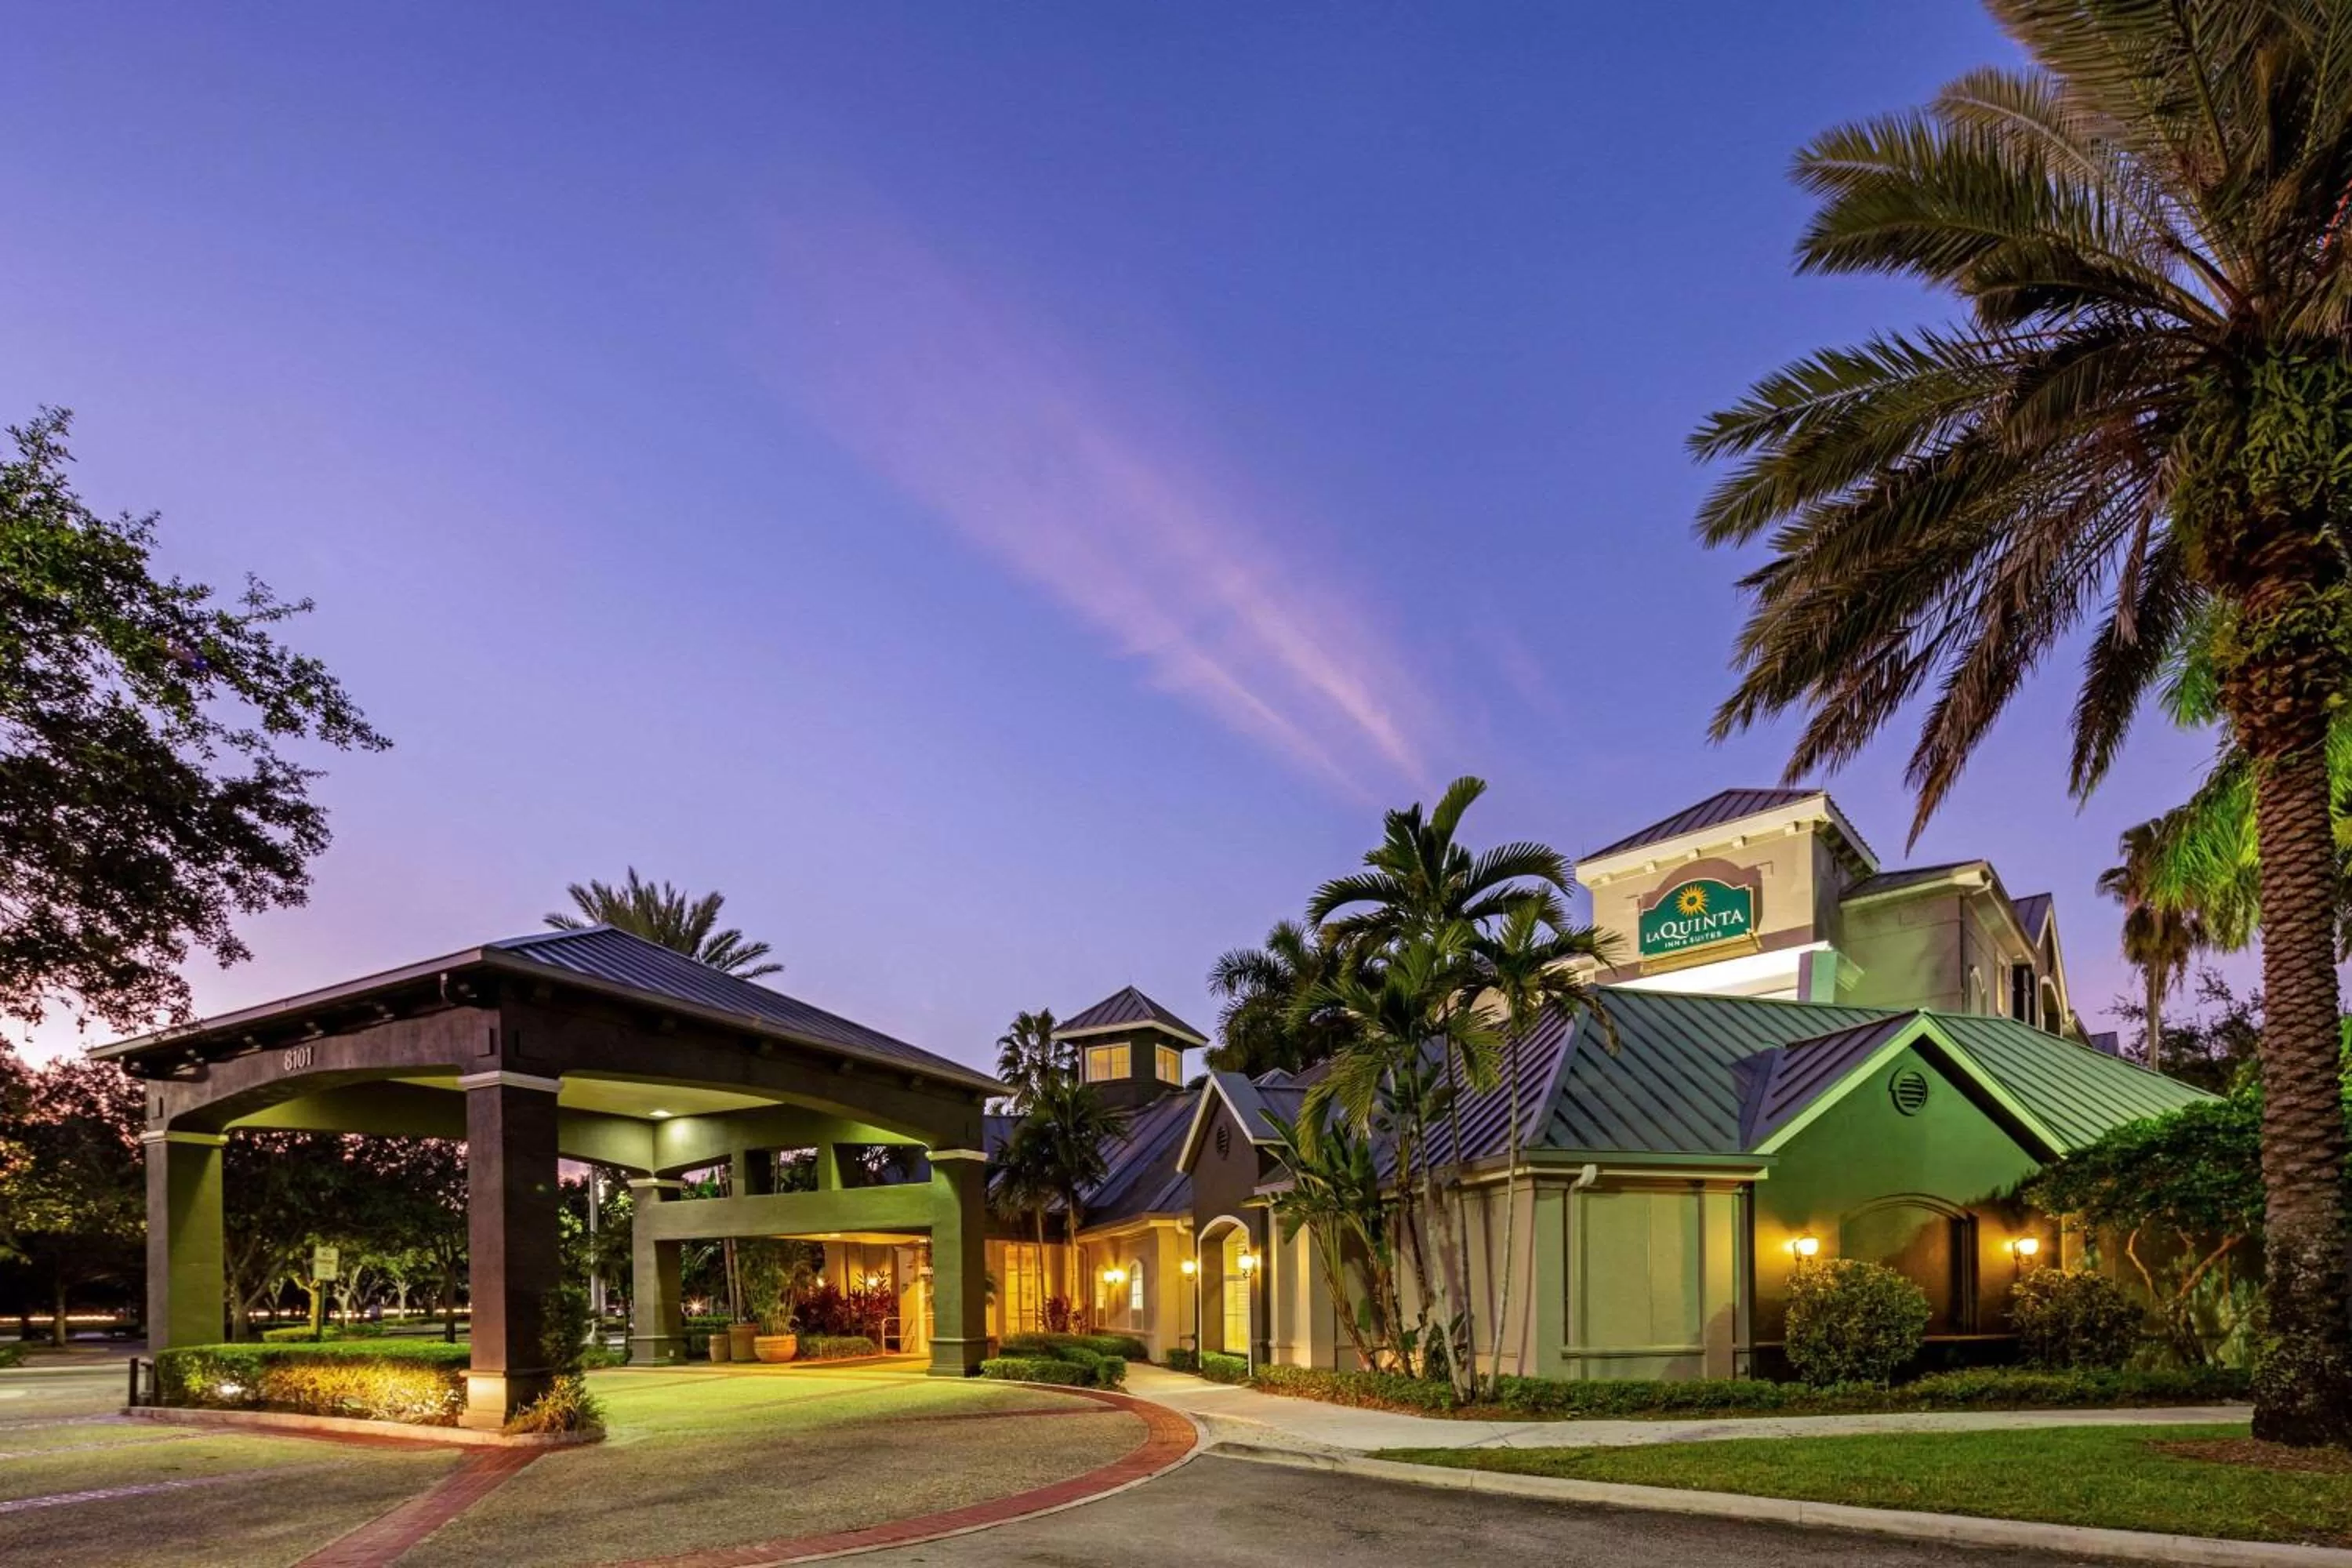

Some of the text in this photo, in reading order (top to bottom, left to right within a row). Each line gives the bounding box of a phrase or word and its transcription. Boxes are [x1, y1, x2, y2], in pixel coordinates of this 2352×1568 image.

[1664, 940, 1680, 949] INN
[1689, 931, 1722, 943] SUITES
[284, 1047, 311, 1071] 8101
